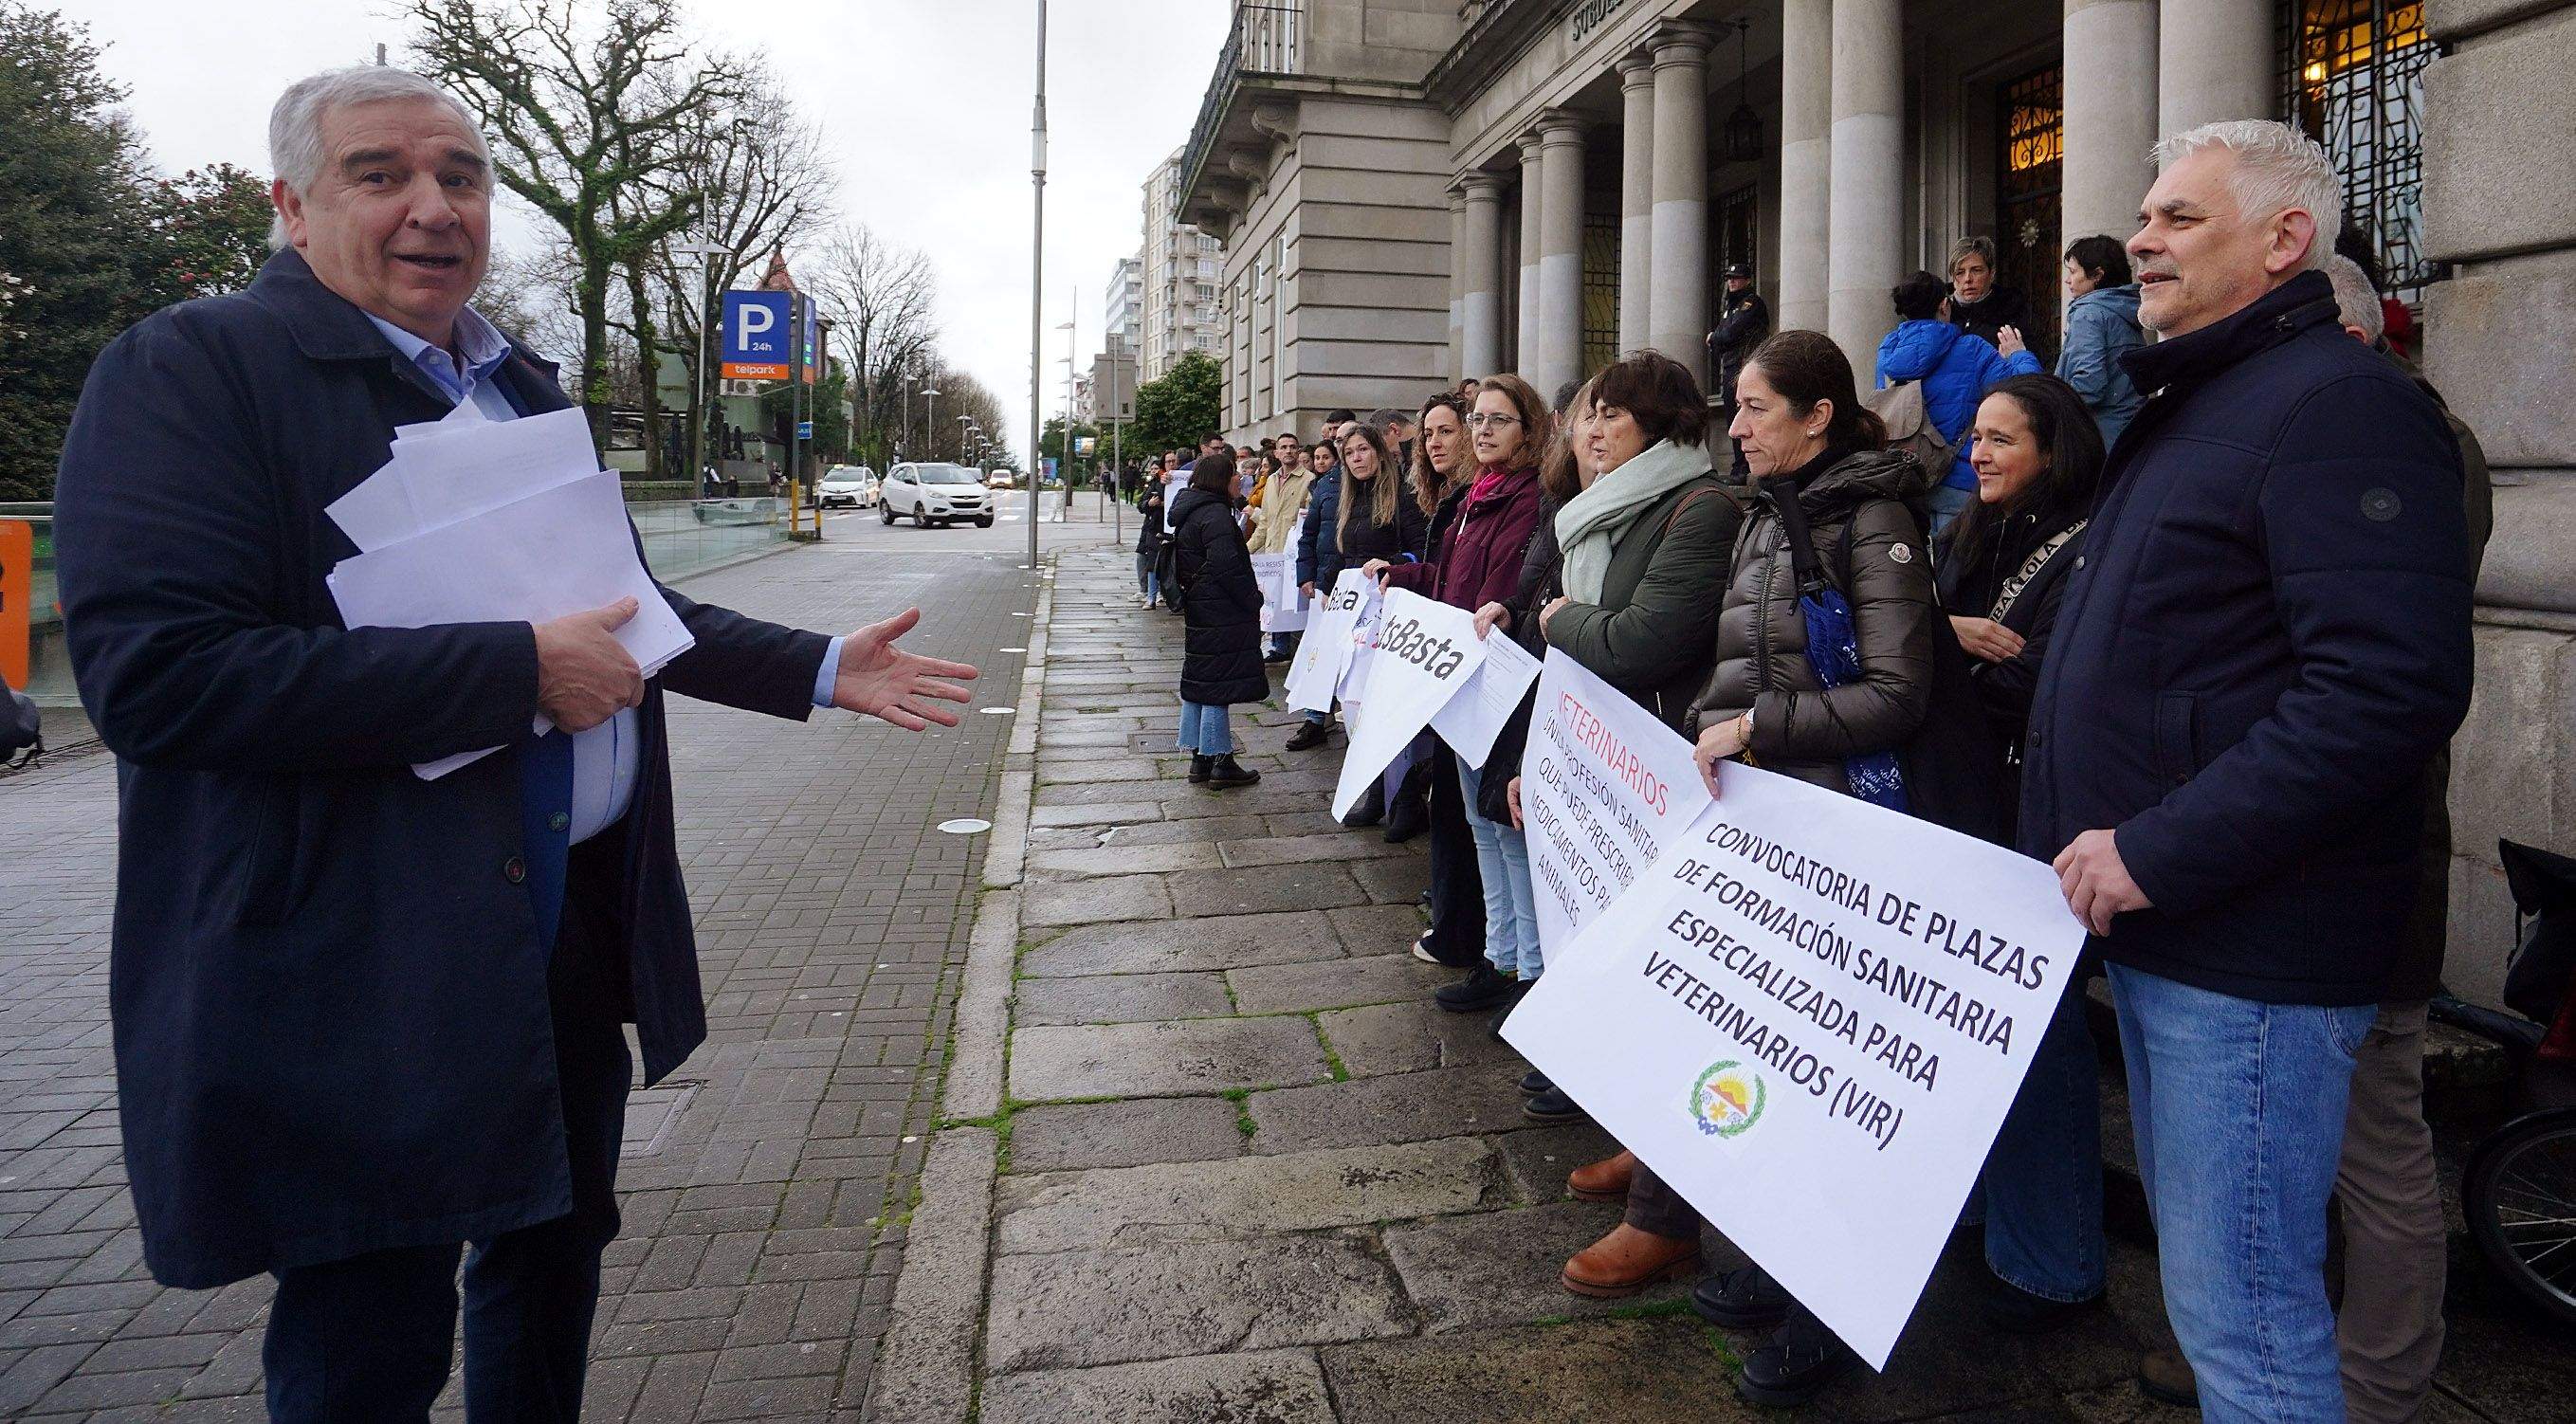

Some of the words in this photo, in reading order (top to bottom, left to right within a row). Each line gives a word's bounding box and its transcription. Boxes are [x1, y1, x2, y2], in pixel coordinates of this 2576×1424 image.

[735, 364, 776, 375] telpark
[739, 303, 775, 351] P
[752, 341, 773, 352] 24h
[1377, 614, 1464, 681] tsBasta
[1539, 757, 1562, 793] QUE
[1561, 780, 1592, 830] PUEDE
[1558, 690, 1669, 816] VETERINARIOS
[1530, 788, 1599, 895] MEDICAMENTOS
[1537, 853, 1580, 927] ANIMALES
[1706, 823, 1871, 917] CONVOCATORIA
[1876, 892, 1921, 936] DE
[1924, 911, 2050, 990] PLAZAS
[1667, 909, 1858, 1045] ESPECIALIZADA
[1861, 1022, 1940, 1092] PARA
[1673, 858, 1710, 885] DE
[1703, 871, 1852, 971] FORMACIÓN
[1853, 948, 2013, 1055] SANITARIA
[1643, 951, 1835, 1096] VETERINARIOS
[1829, 1076, 1903, 1151] (VIR)
